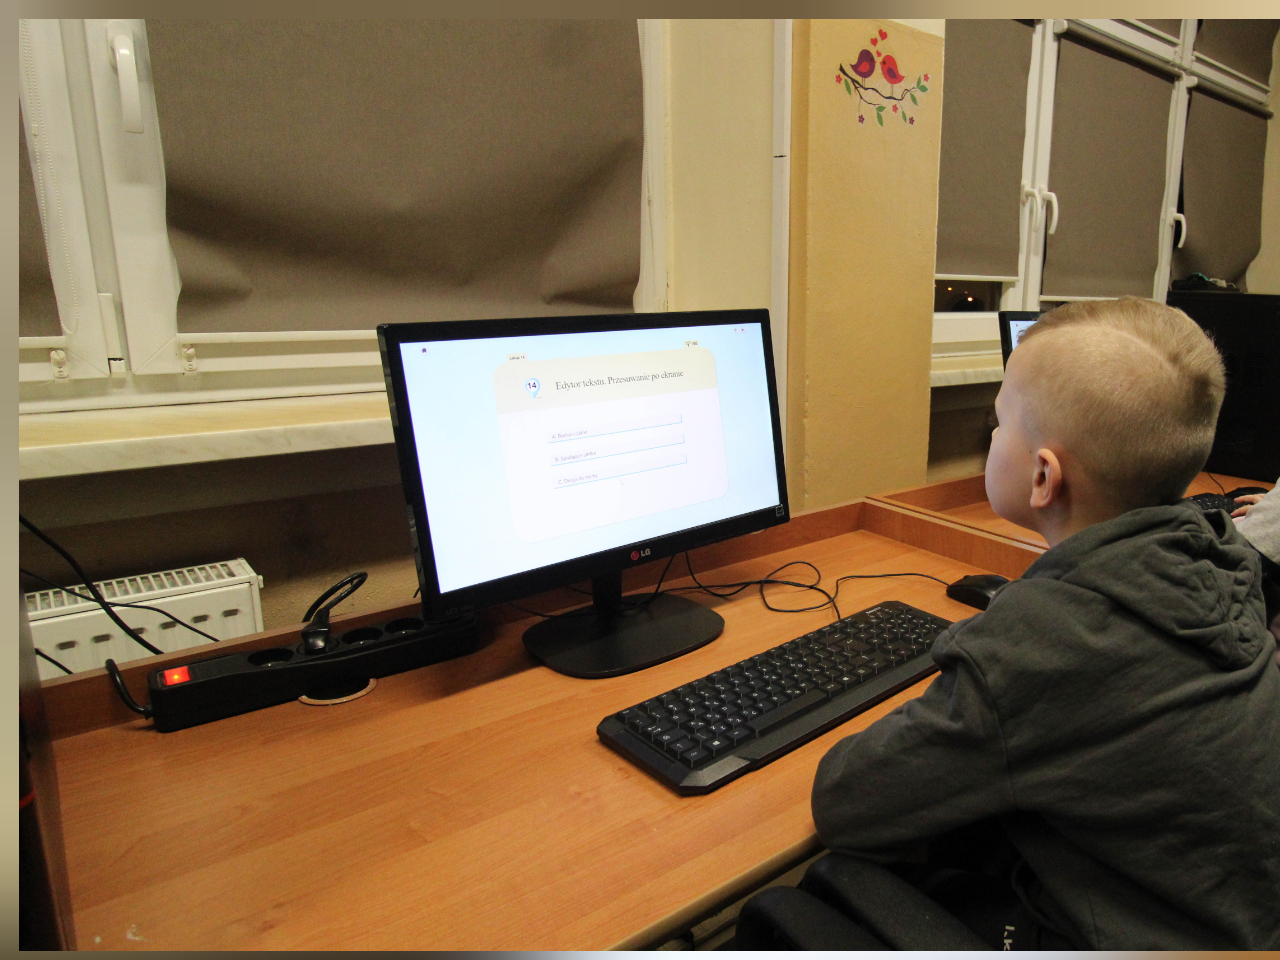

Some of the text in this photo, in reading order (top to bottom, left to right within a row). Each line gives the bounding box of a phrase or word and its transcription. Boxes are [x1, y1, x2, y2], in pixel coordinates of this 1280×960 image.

[527, 381, 538, 390] 14
[555, 370, 684, 393] Edytor tekstu. Przesuwanie po ekranie
[640, 548, 651, 558] LG
